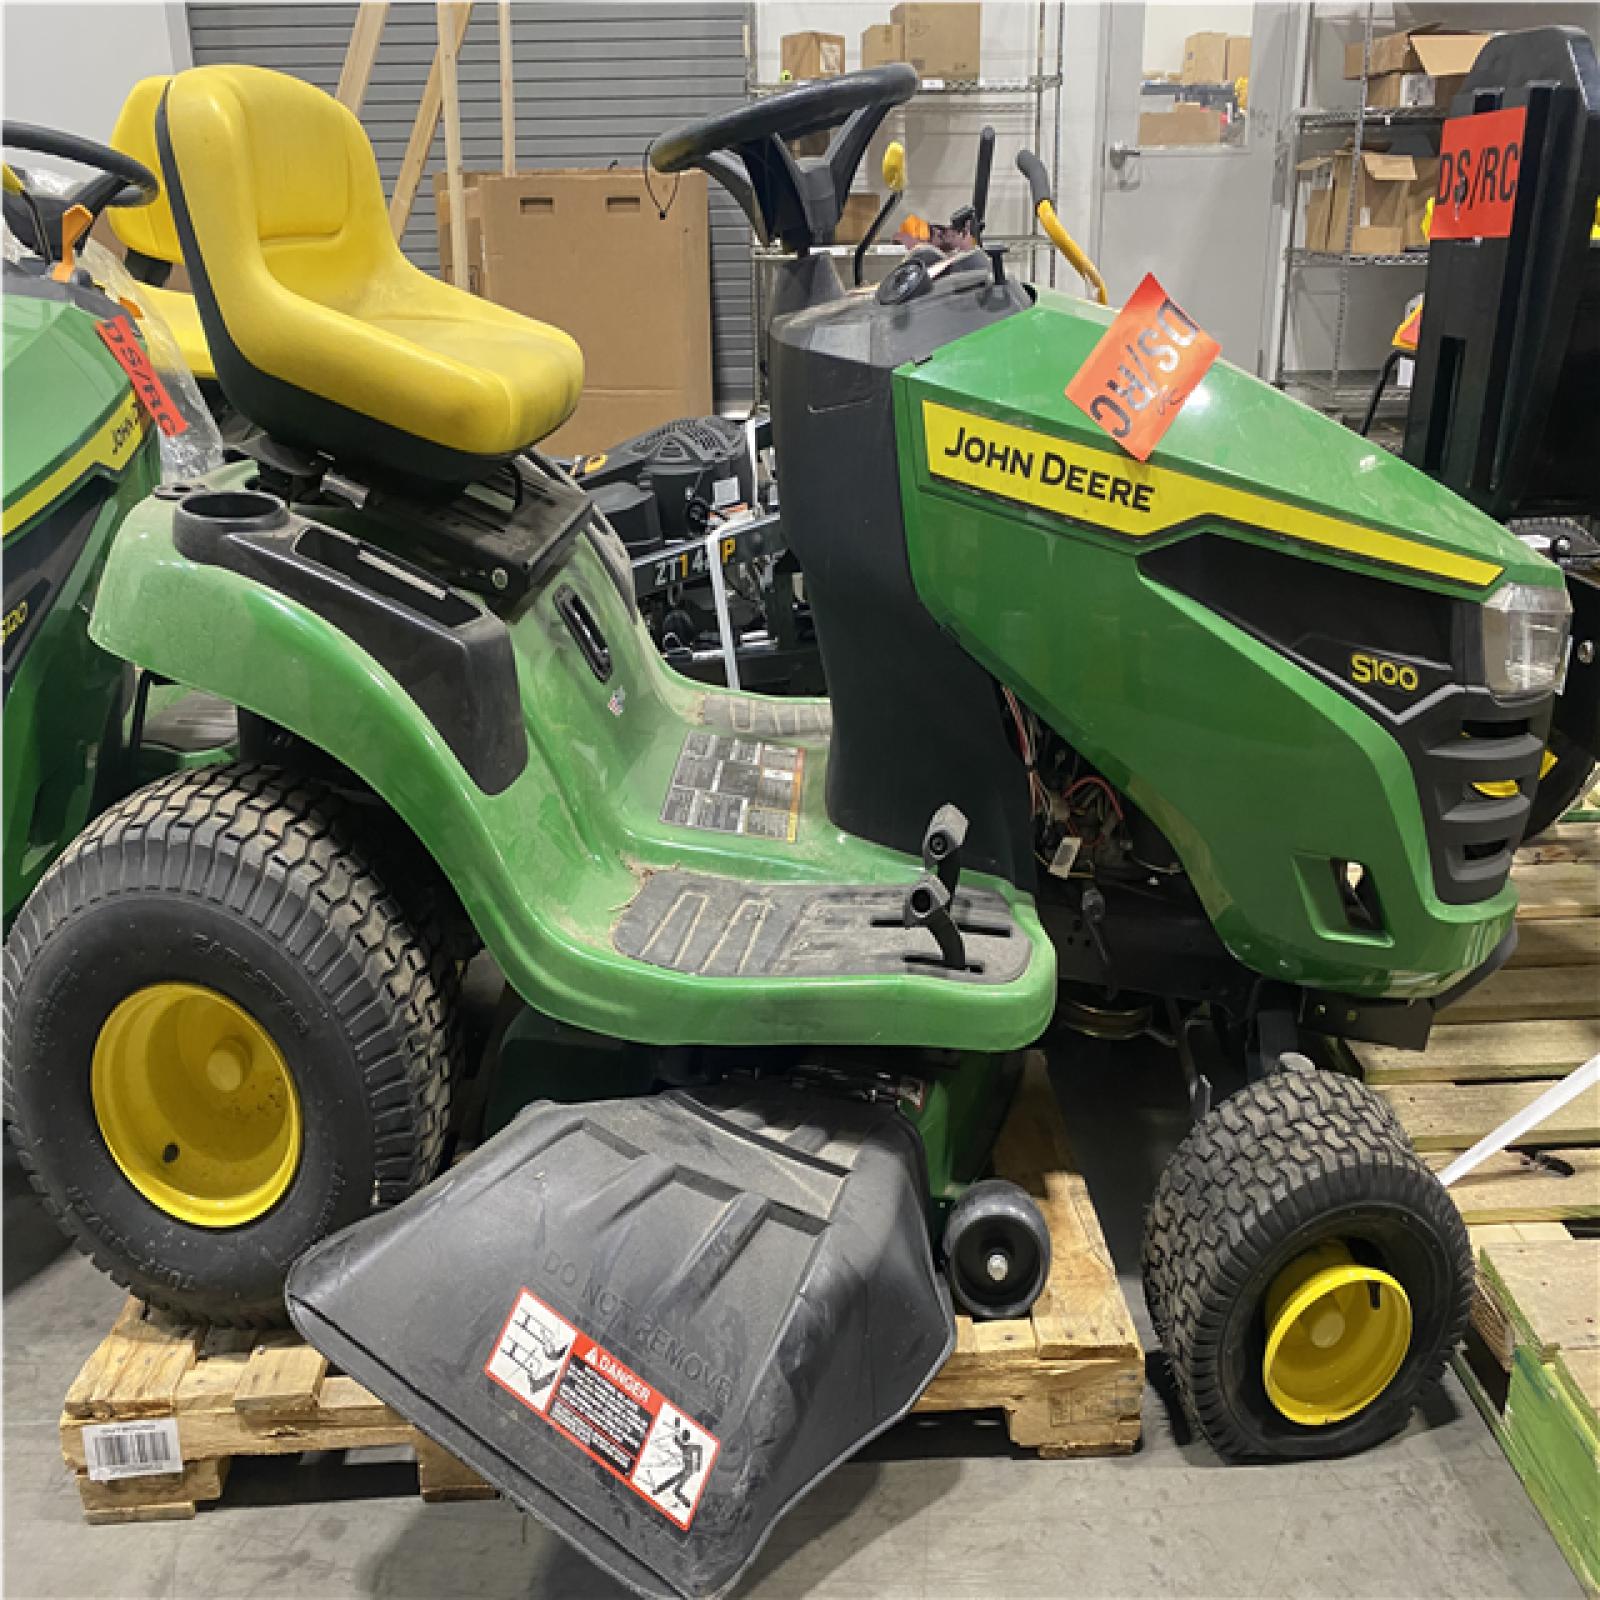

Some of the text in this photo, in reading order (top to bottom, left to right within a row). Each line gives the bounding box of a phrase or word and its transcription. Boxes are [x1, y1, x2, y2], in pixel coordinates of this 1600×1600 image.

[1435, 142, 1518, 211] DS/RC
[103, 320, 177, 434] DS/RC
[1089, 297, 1200, 438] DS/RC
[944, 426, 1155, 512] JOHN DEERE
[1351, 654, 1418, 691] S100
[599, 1354, 651, 1404] DANGER
